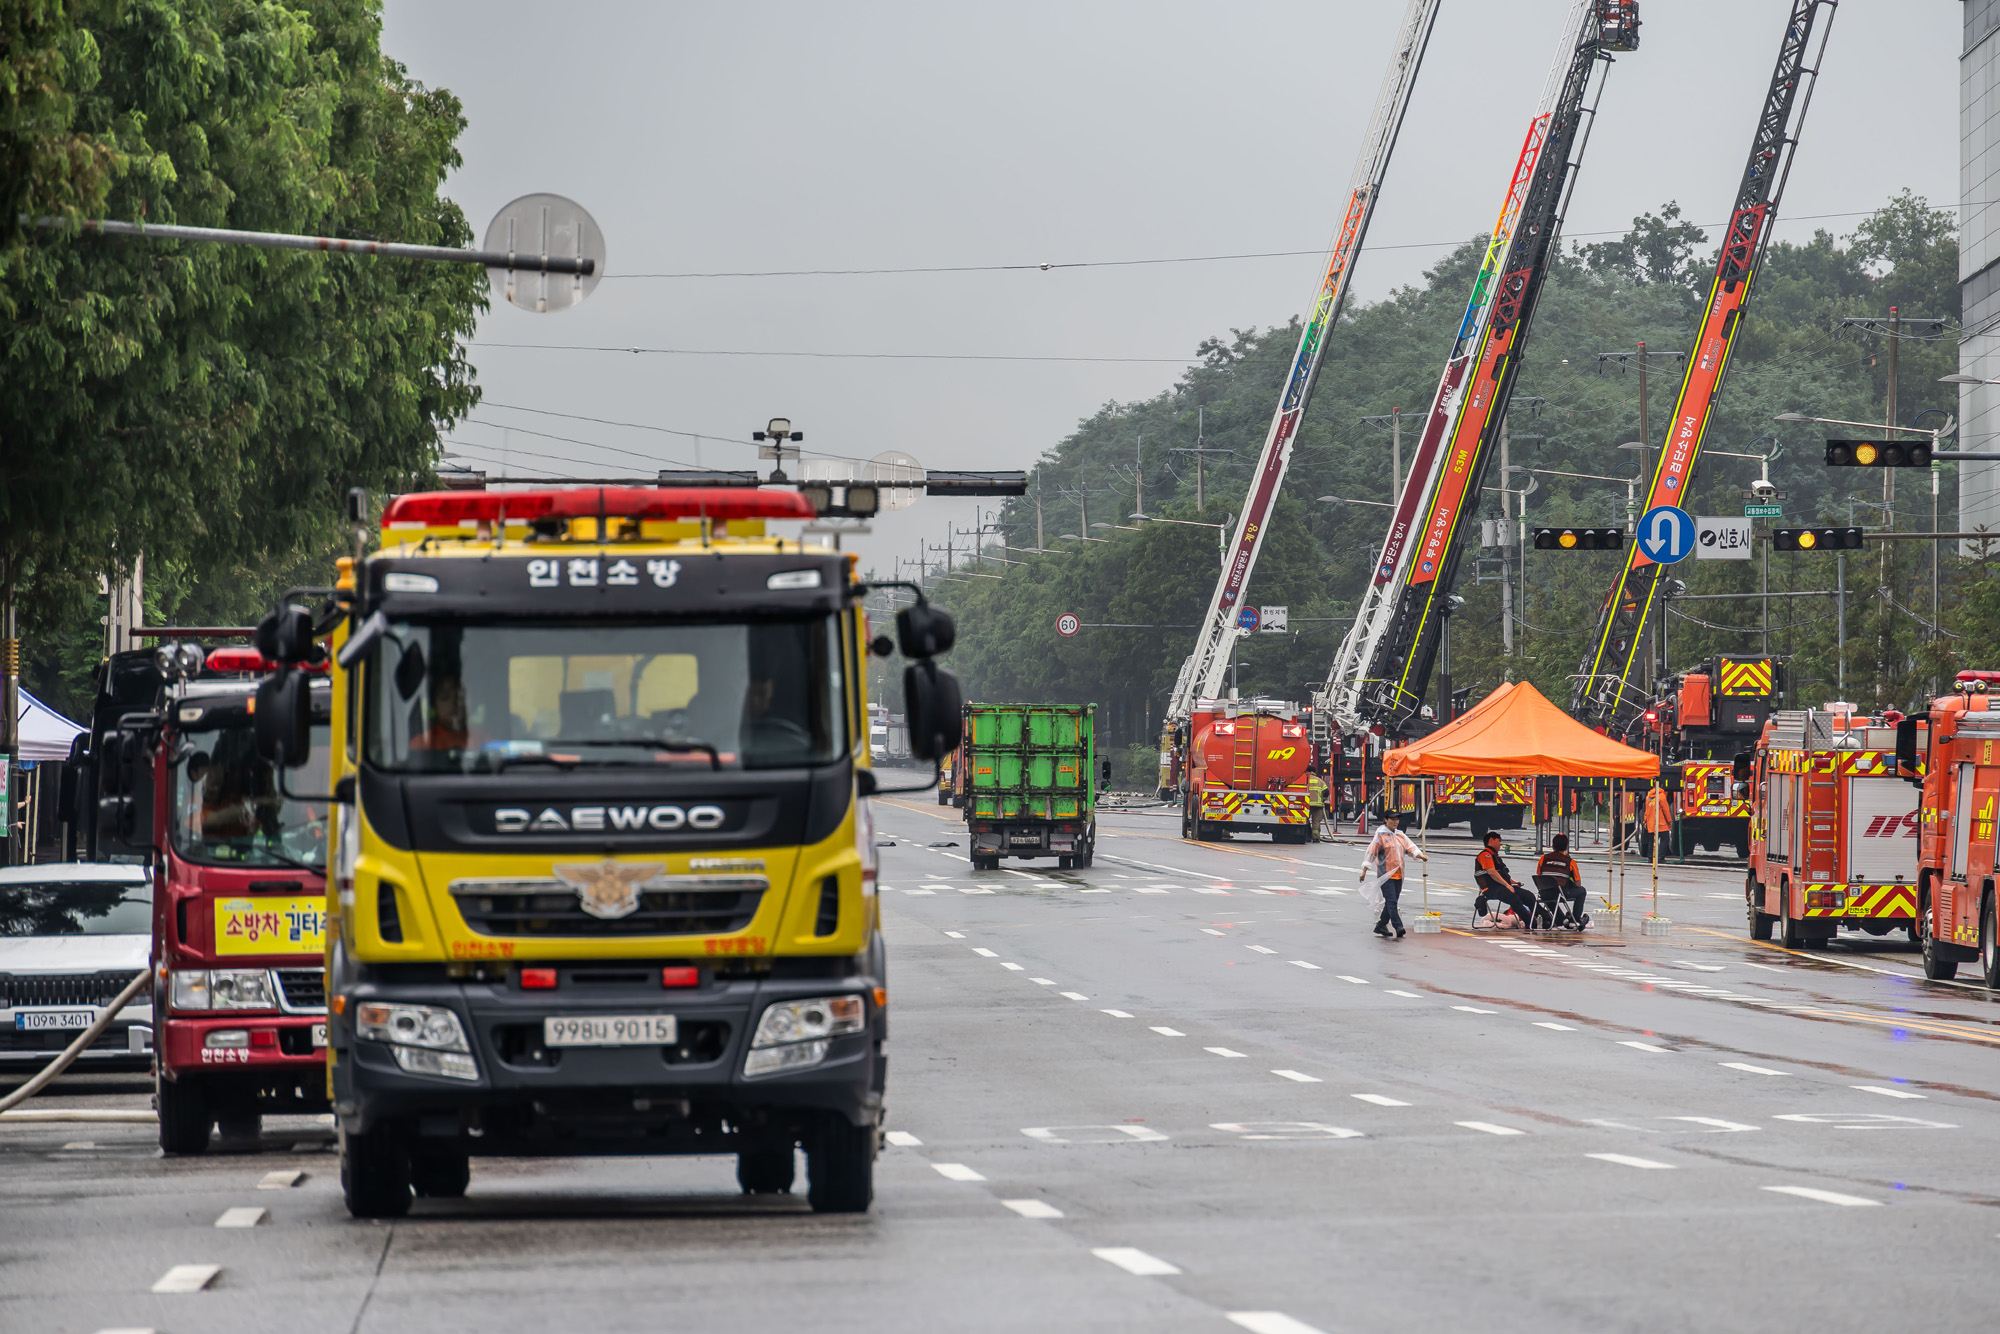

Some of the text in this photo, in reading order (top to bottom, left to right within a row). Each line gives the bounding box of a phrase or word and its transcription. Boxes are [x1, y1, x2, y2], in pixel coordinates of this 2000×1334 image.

[1440, 384, 1453, 408] ERL53
[1669, 416, 1697, 474] 검단소방서
[1453, 449, 1468, 474] 53M
[1244, 523, 1258, 542] 계양
[1384, 521, 1406, 565] 공단소방서
[1426, 507, 1449, 559] 부평소방서
[1718, 528, 1749, 549] 신호시
[527, 559, 681, 588] 인천소방
[1231, 550, 1249, 588] 인천소방본부
[1061, 620, 1076, 630] 60
[1267, 747, 1296, 760] 119
[495, 805, 725, 832] DAEWOO
[226, 912, 280, 942] 소방차
[60, 1014, 88, 1026] 3401
[613, 1018, 668, 1040] 9015
[201, 1048, 249, 1063] 인천소방
